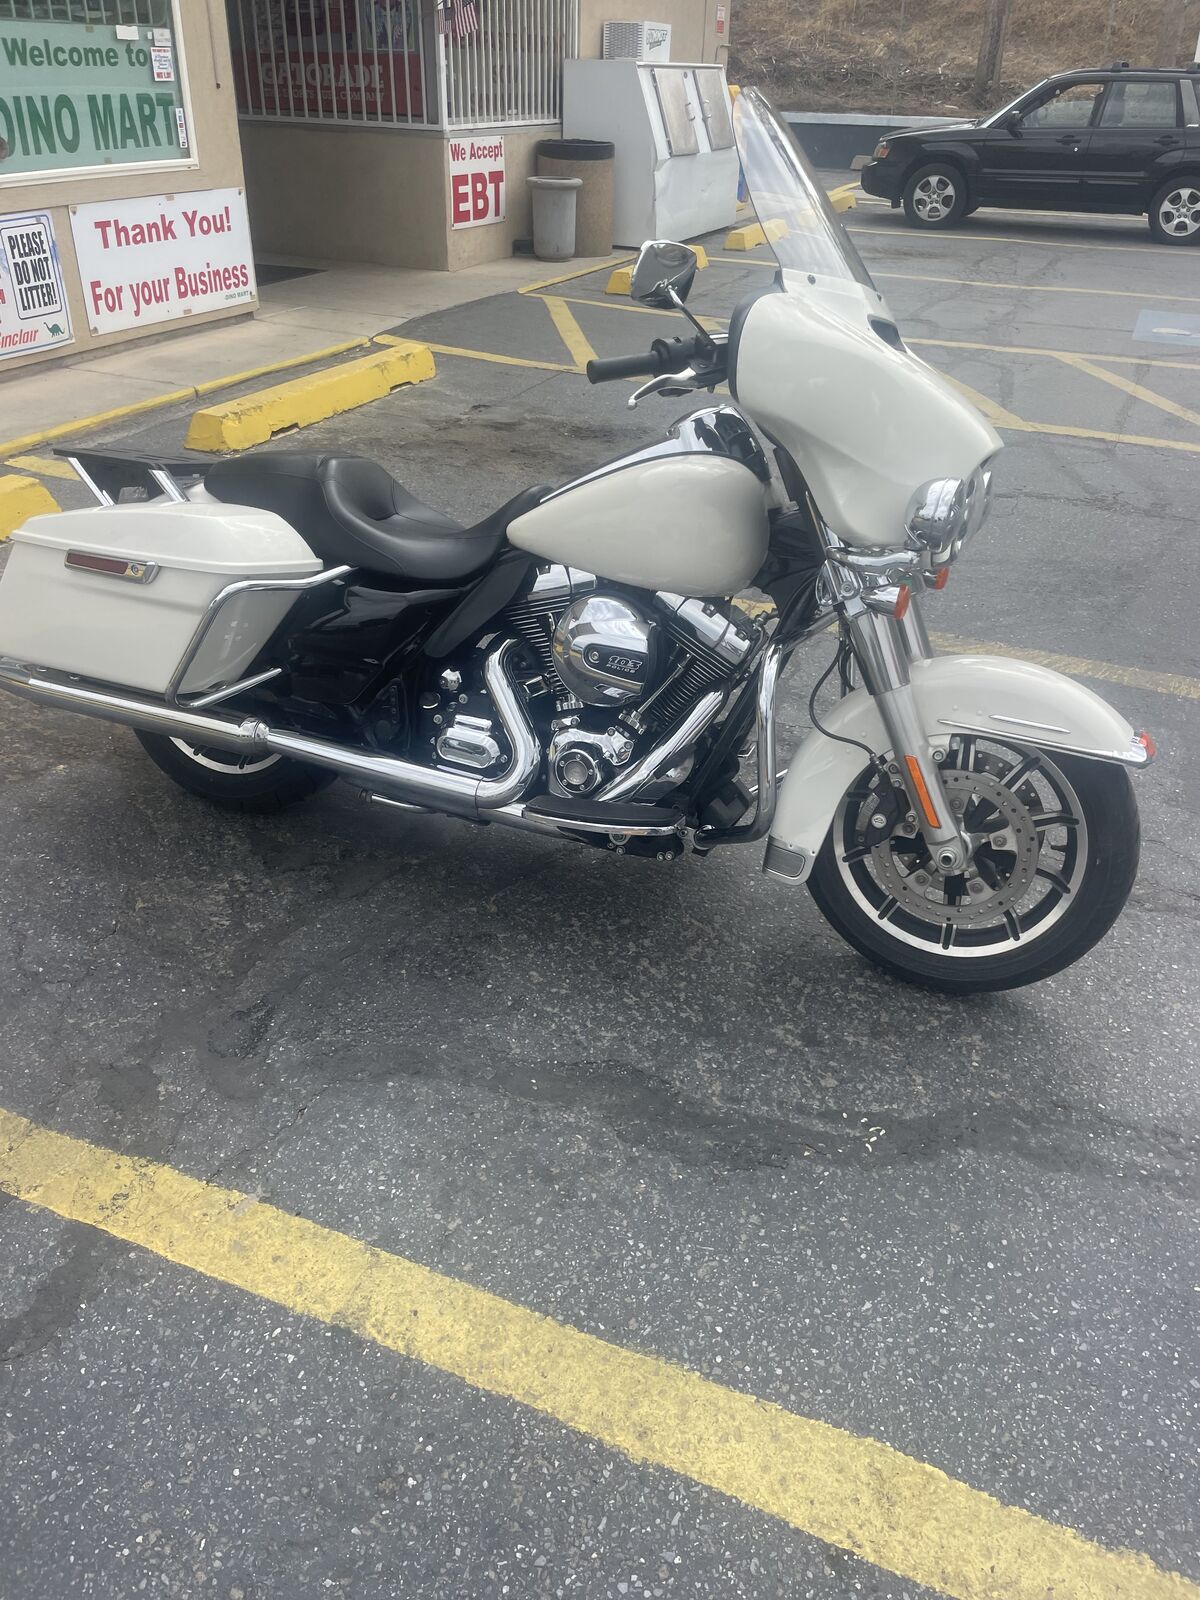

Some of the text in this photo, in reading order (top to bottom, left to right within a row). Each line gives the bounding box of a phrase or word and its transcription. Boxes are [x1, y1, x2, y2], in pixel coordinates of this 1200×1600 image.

[1, 37, 119, 67] Welcome
[125, 42, 148, 67] to
[261, 62, 384, 89] GATORADE
[87, 93, 174, 151] MART
[450, 141, 503, 162] We Accept
[452, 170, 504, 224] EBT
[94, 206, 232, 249] Thank You!
[7, 231, 47, 260] PLEASE
[13, 256, 52, 286] DO NOT
[18, 282, 58, 311] LITTER!
[90, 262, 249, 317] For your Business
[0, 329, 38, 349] inclair
